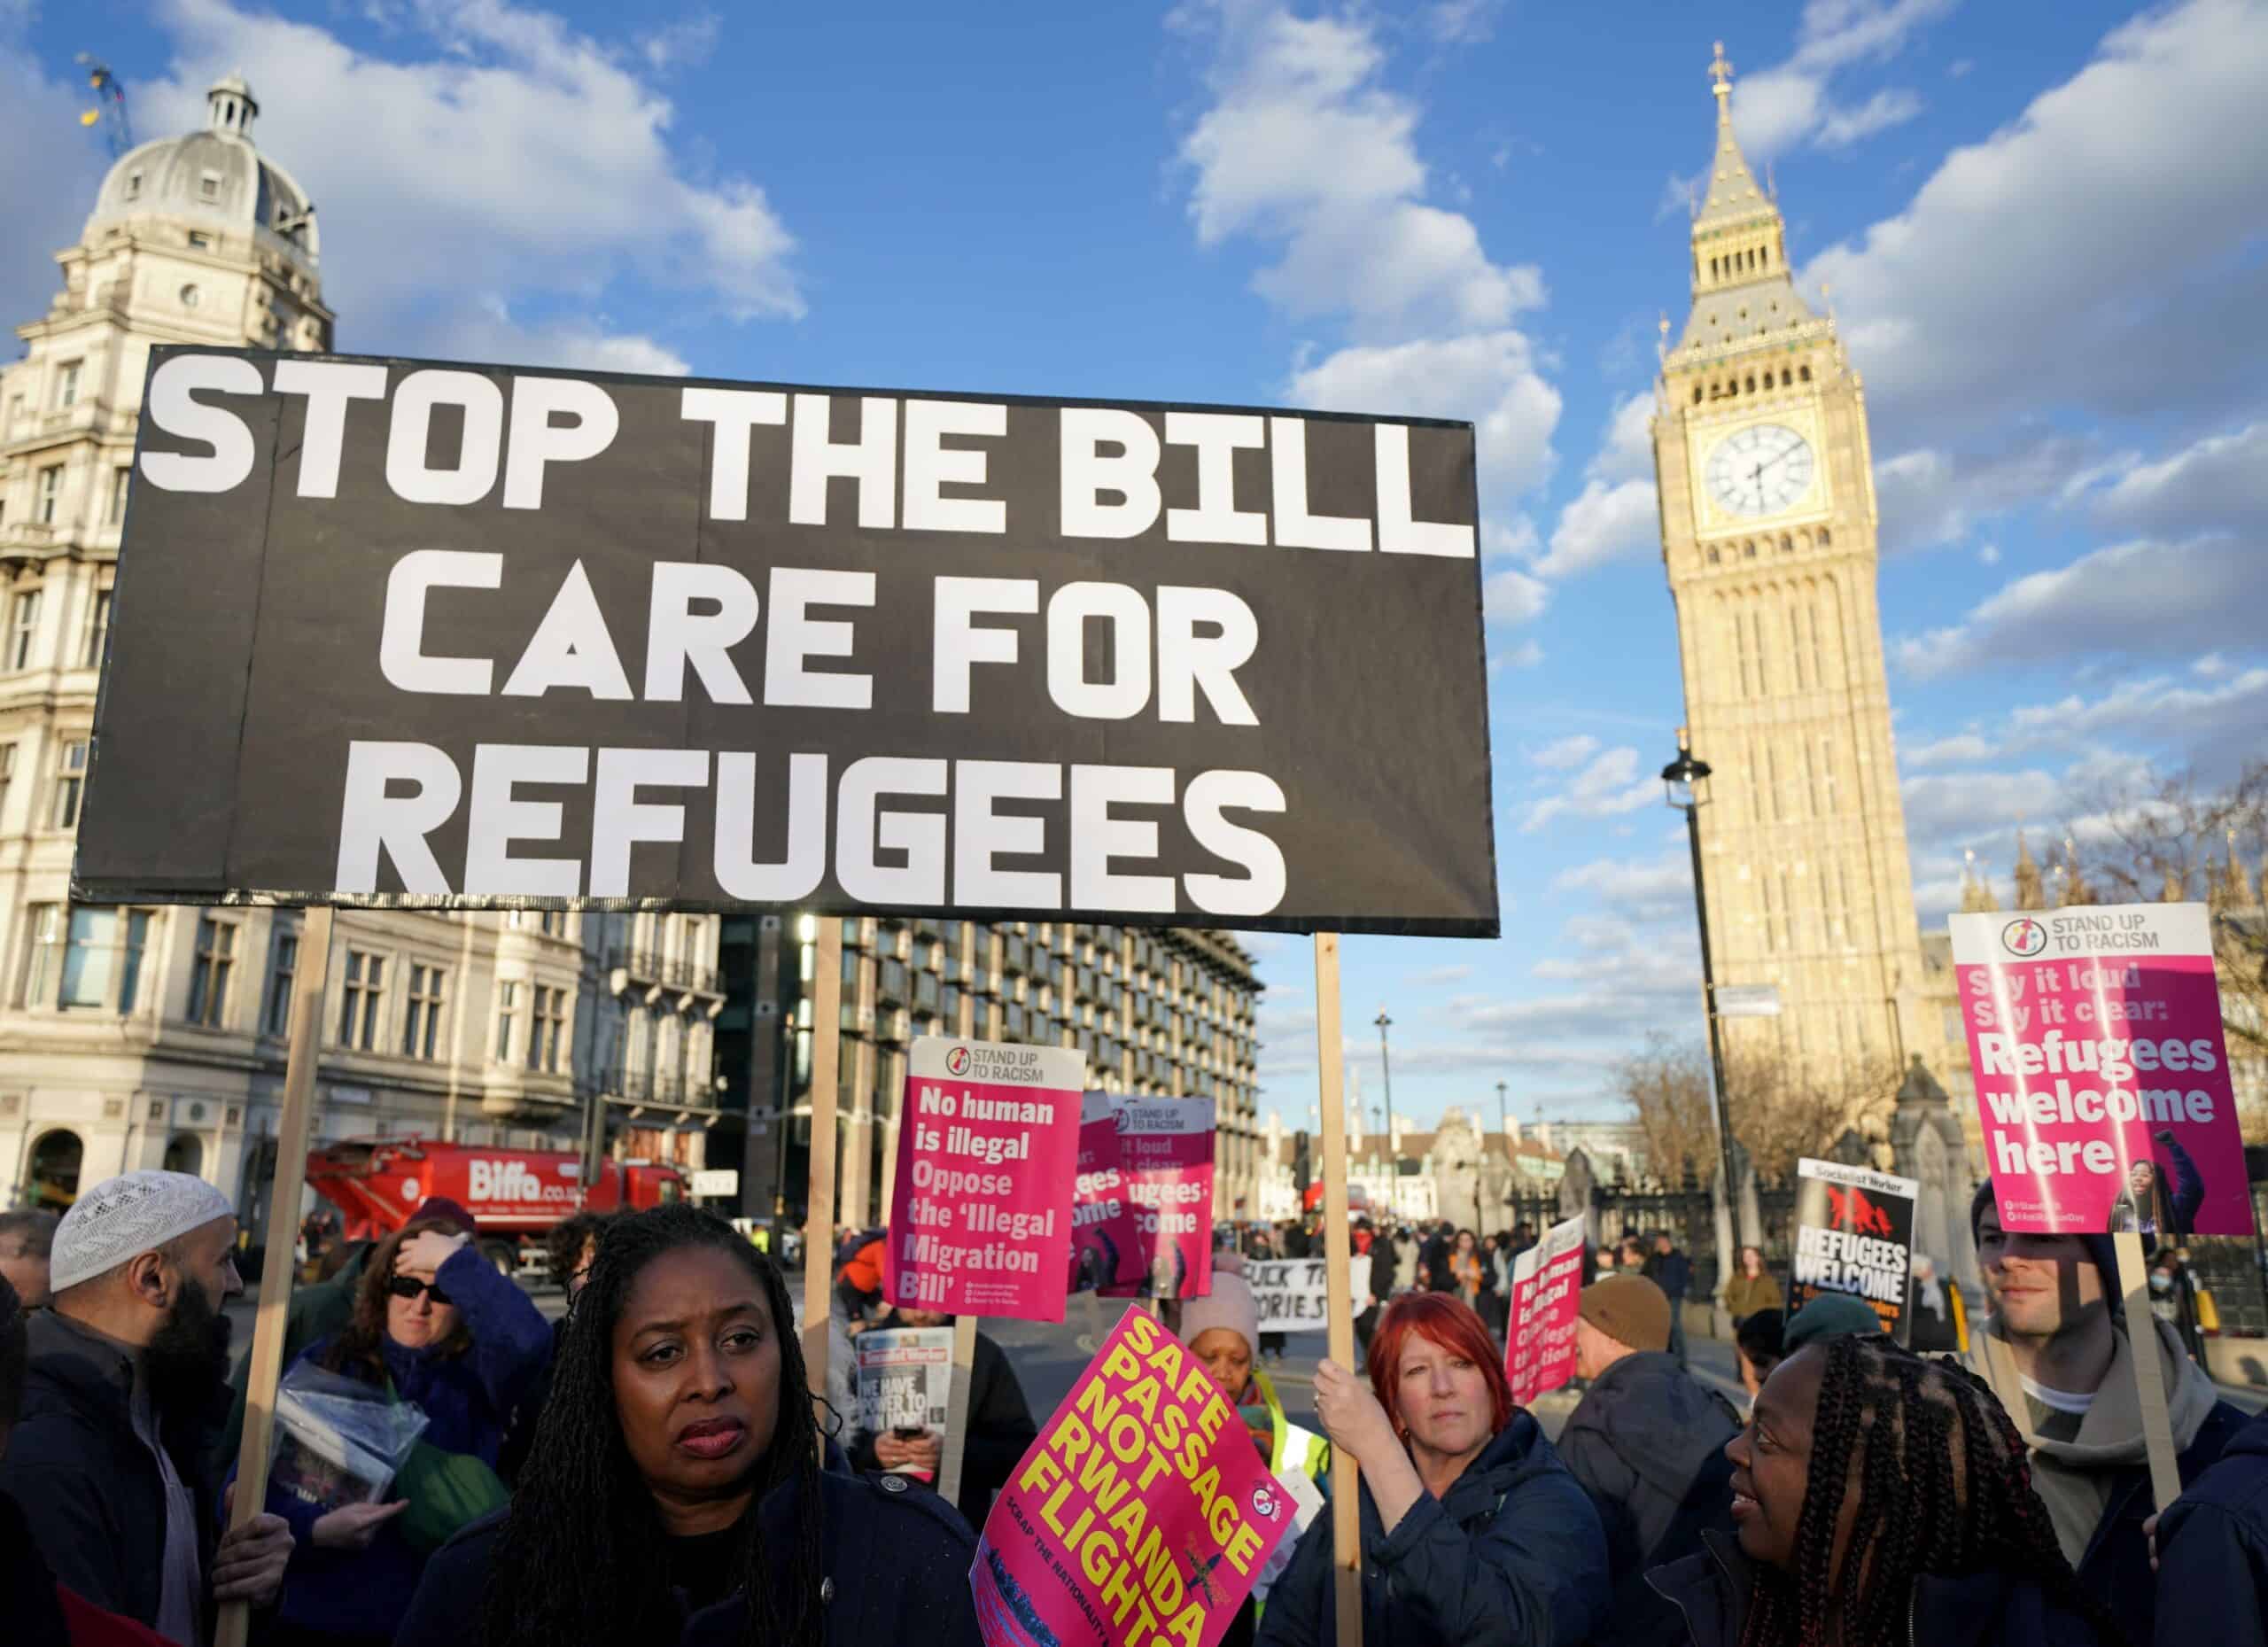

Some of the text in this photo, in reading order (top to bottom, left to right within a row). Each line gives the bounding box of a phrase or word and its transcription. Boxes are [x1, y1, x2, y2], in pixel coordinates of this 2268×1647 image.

[139, 353, 1475, 559] STOP THE BILL
[380, 548, 1261, 726] CARE FOR
[335, 741, 1287, 917] REFUGEES
[2052, 913, 2145, 934] STAND UP
[2054, 931, 2160, 952] TO RACISM
[1968, 961, 2141, 1002] Sy it loud
[1972, 999, 2031, 1033] Sy
[2039, 997, 2066, 1025] it
[973, 1063, 1045, 1083] TO RACISM
[974, 1048, 1038, 1067] STAND UP
[1977, 1029, 2217, 1083] Refugees
[919, 1086, 1054, 1125] No human
[1131, 1108, 1179, 1119] STAND UP
[1986, 1078, 2216, 1124] welcome
[914, 1123, 1029, 1164] is illegal
[1133, 1119, 1184, 1130] TO RACISM
[1993, 1130, 2117, 1176] here
[912, 1160, 1013, 1198] Oppose
[1126, 1179, 1201, 1209] ugees
[907, 1197, 952, 1228] the
[903, 1233, 1039, 1274] Migration
[1798, 1224, 1907, 1274] REFUGEES
[1795, 1254, 1905, 1304] WELCOME
[1123, 1316, 1231, 1445] SAFE
[1076, 1375, 1173, 1492] NOT
[1101, 1342, 1263, 1576] PASSAGE
[1049, 1410, 1206, 1647] RWANDA
[1006, 1496, 1107, 1638] SCRAP THE NATIONALITY
